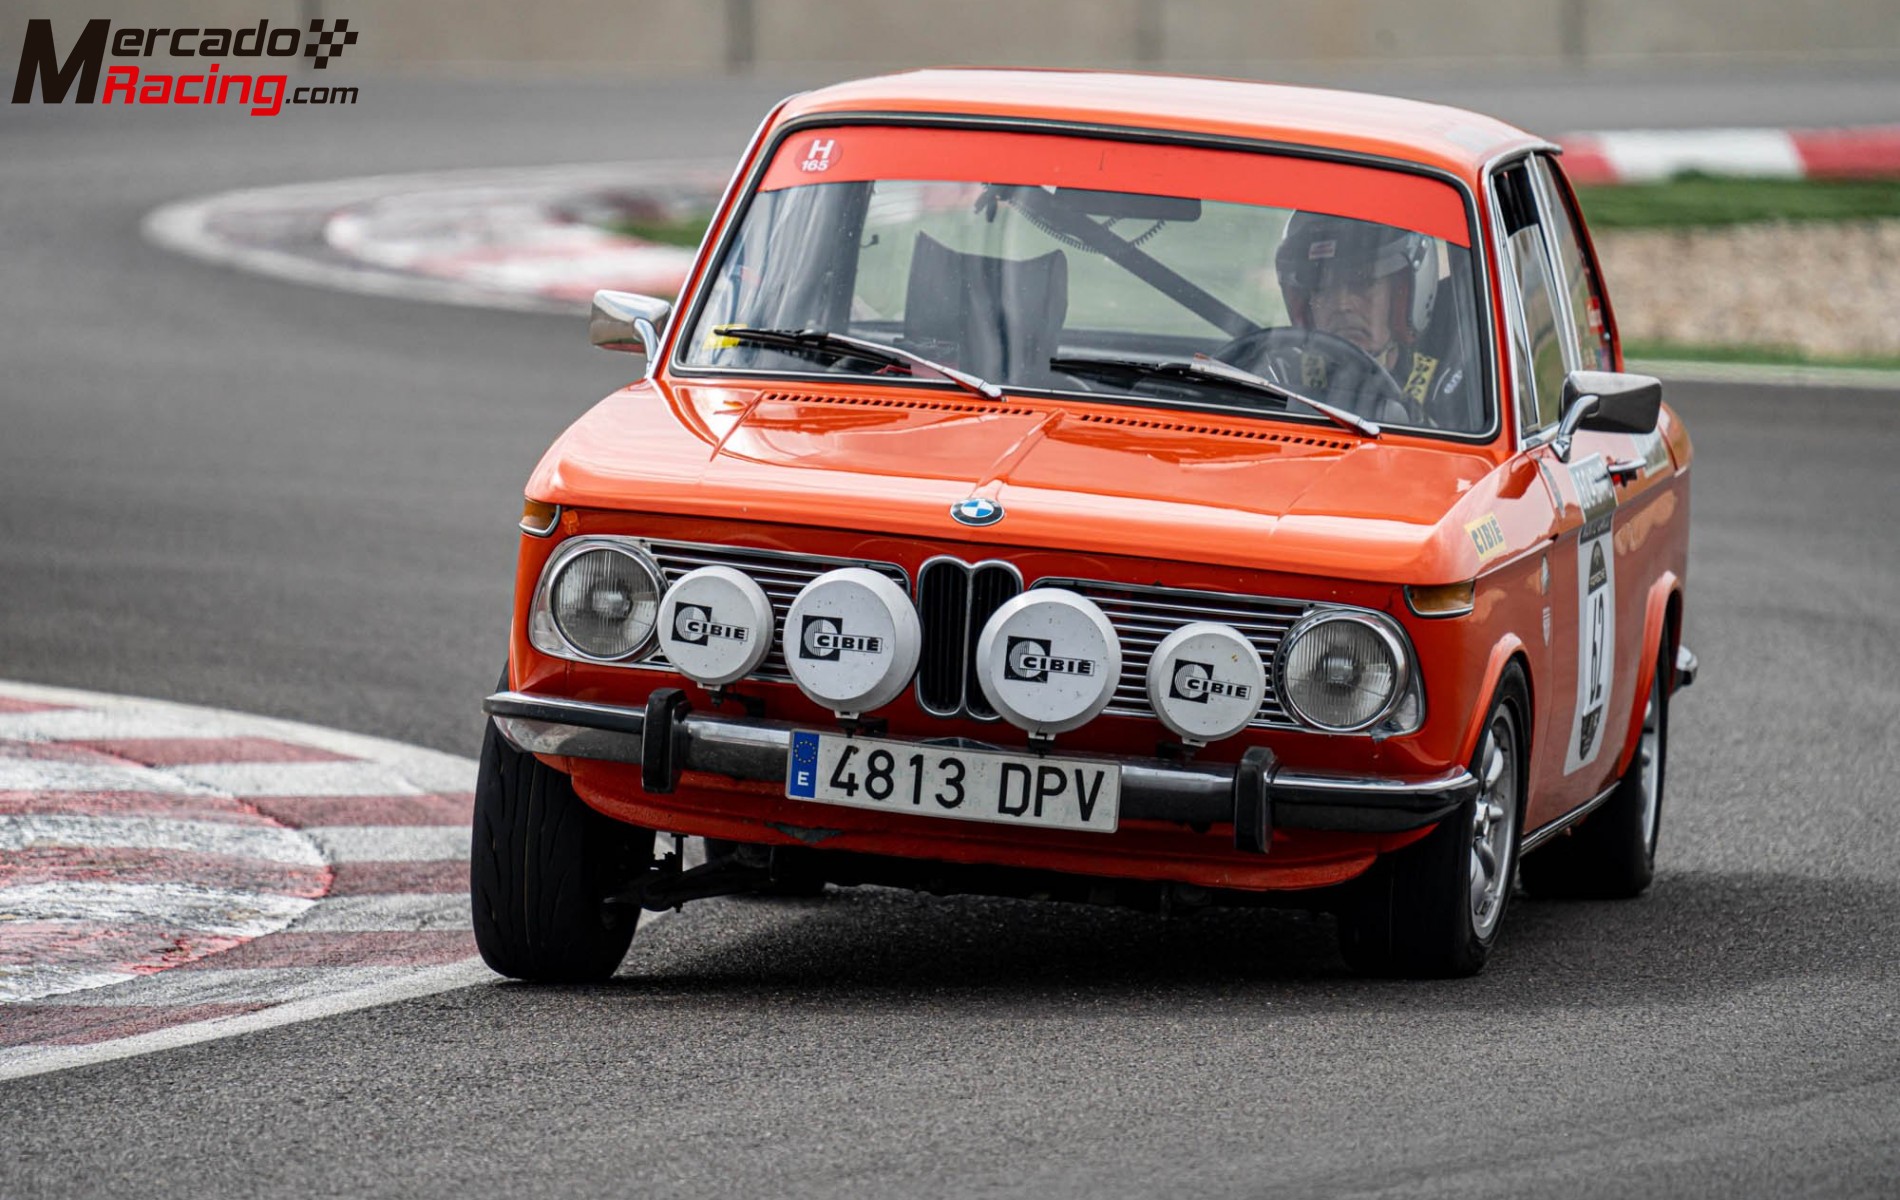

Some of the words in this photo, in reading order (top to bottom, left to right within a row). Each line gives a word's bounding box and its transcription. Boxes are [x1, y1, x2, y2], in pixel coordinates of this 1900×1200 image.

[808, 139, 835, 159] H
[802, 159, 829, 172] 165
[797, 771, 810, 786] E
[829, 745, 966, 809] 4813
[997, 762, 1105, 822] DPV
